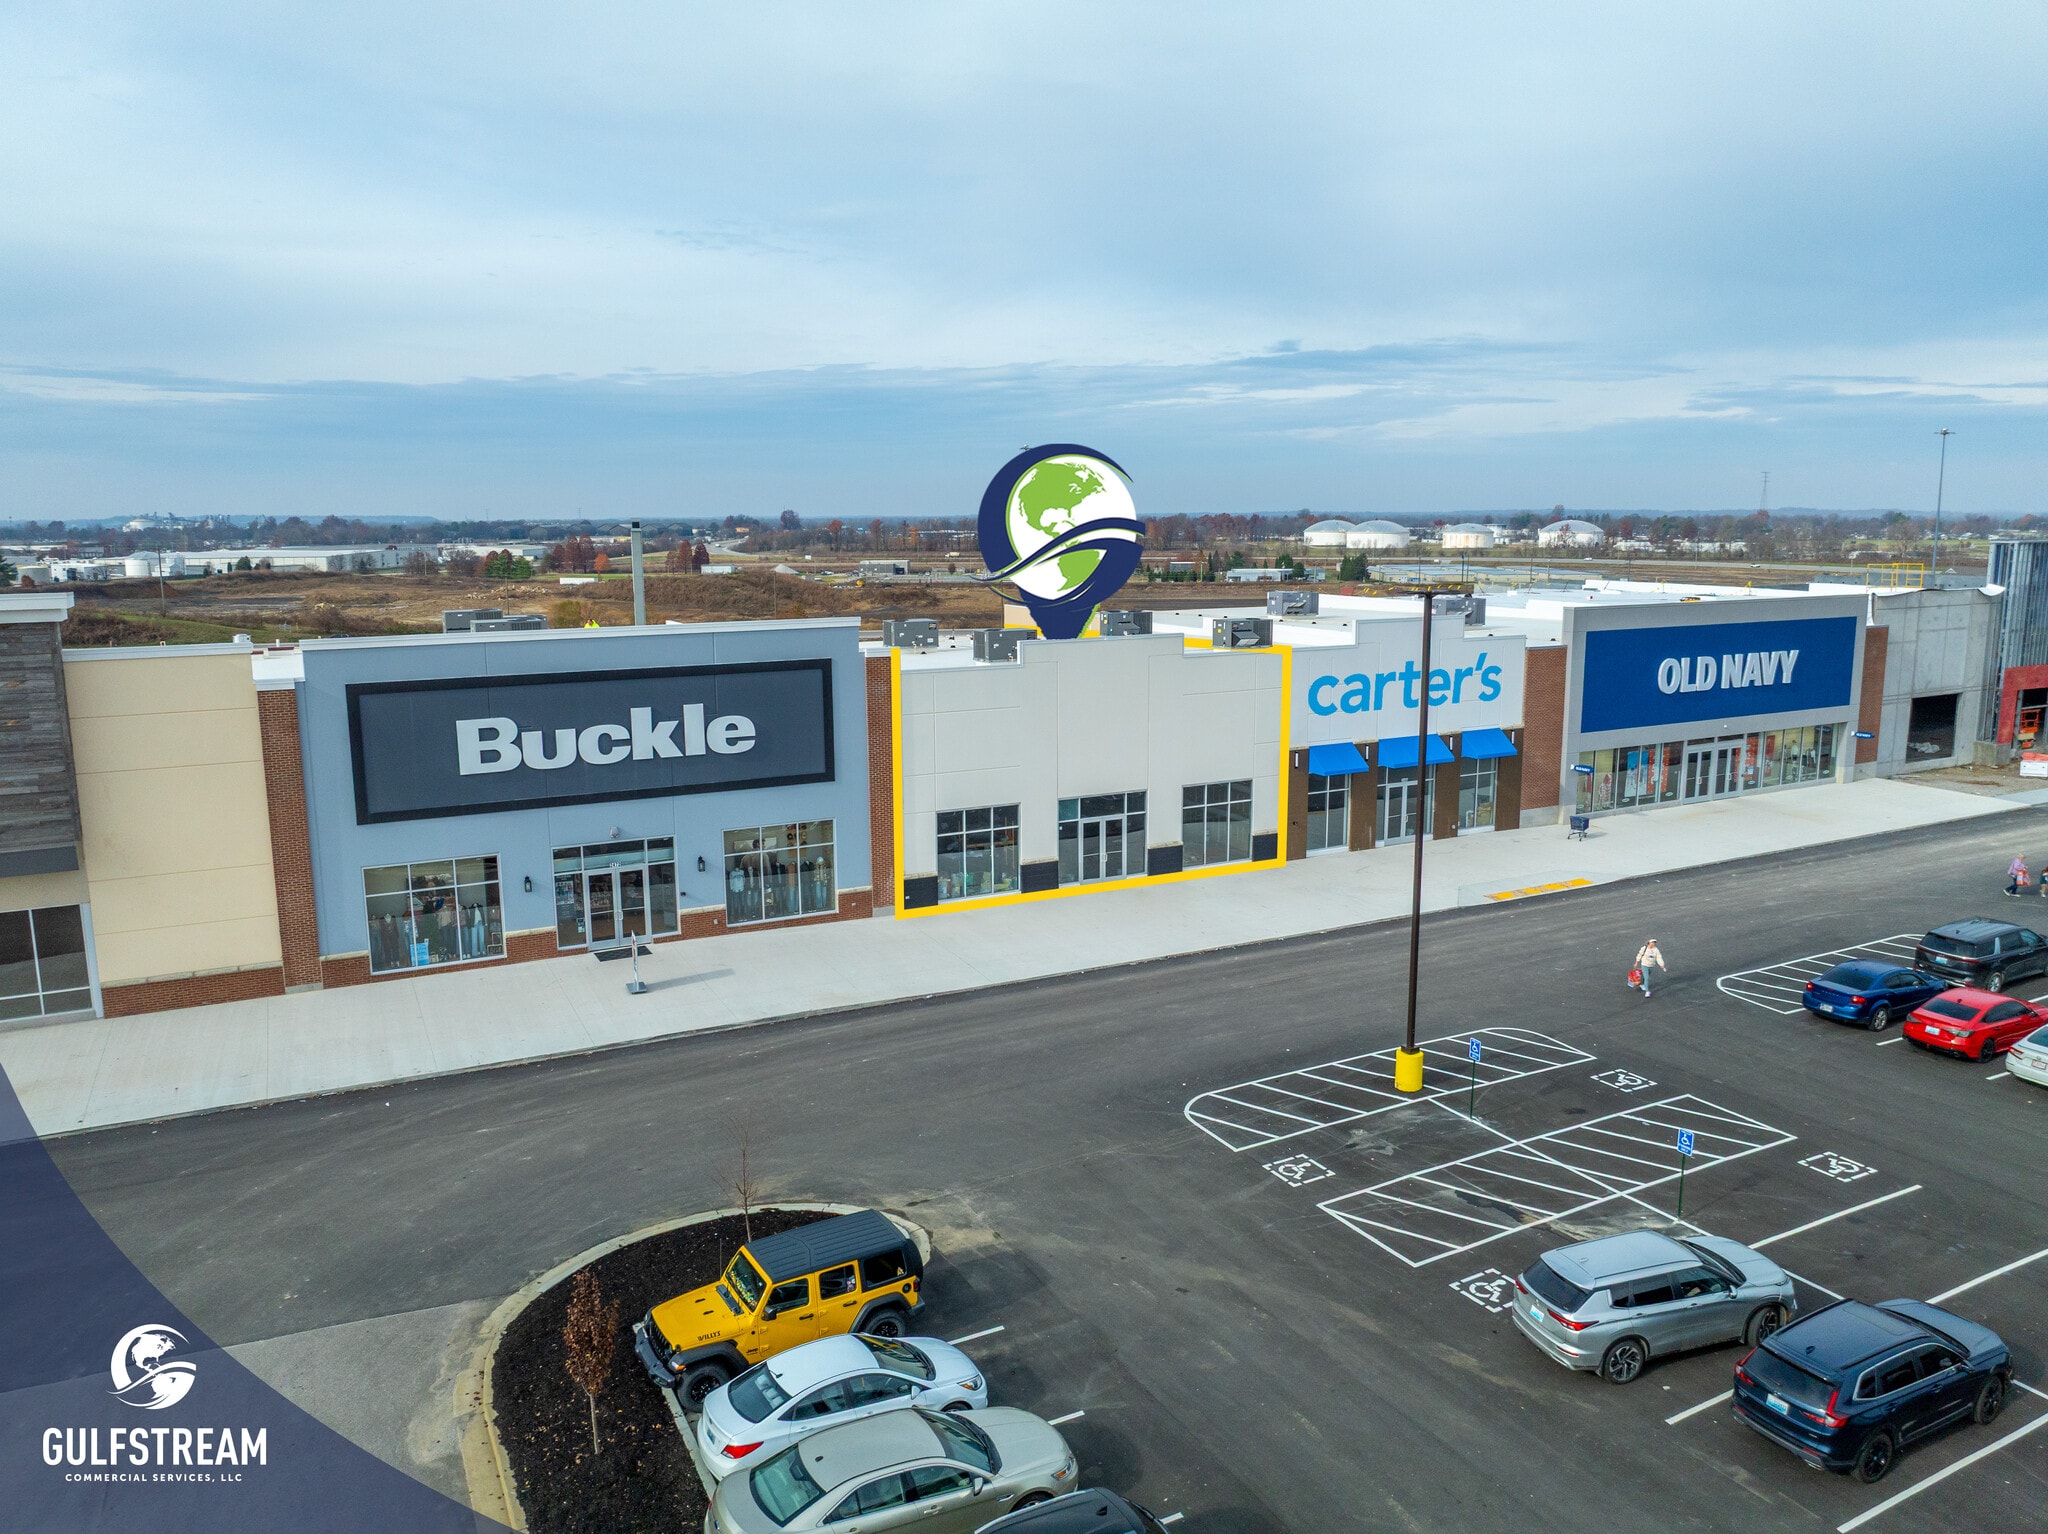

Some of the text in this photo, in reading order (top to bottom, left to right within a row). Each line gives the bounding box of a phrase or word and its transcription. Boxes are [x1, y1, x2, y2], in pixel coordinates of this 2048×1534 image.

[1308, 652, 1503, 716] carter's
[1657, 650, 1799, 694] OLD NAVY
[456, 704, 756, 776] Buckle
[697, 1330, 721, 1342] WILLYS
